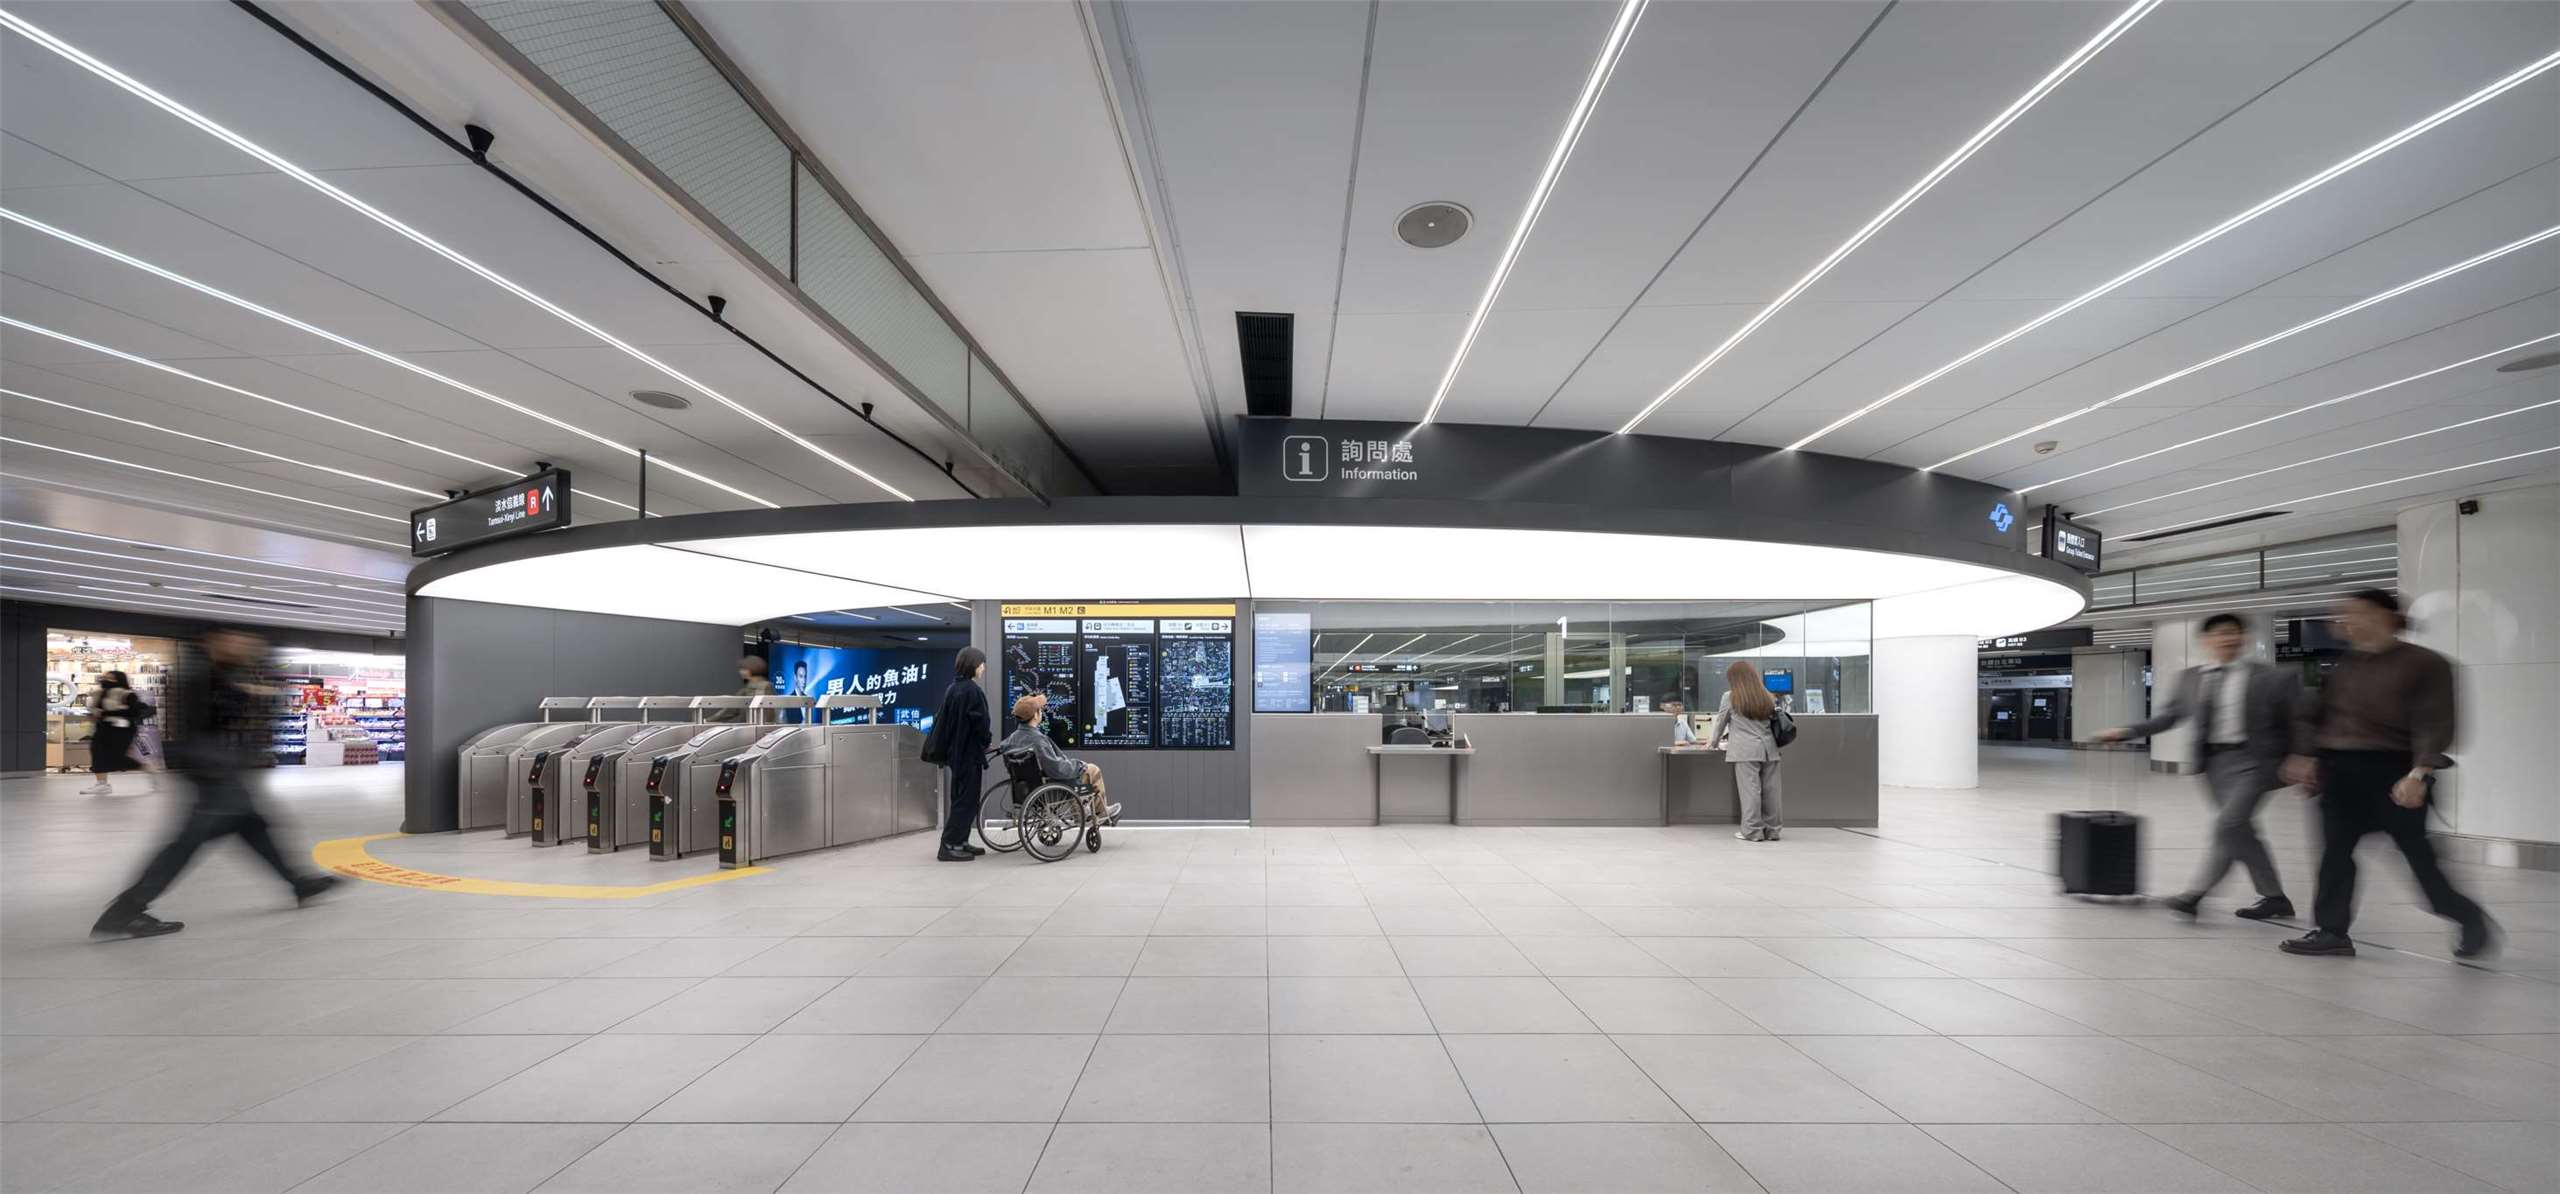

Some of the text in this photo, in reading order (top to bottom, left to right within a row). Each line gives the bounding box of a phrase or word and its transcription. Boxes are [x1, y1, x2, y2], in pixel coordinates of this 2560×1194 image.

[1341, 439, 1414, 463] 詢問處
[1341, 467, 1418, 481] Information
[1556, 616, 1568, 639] 1
